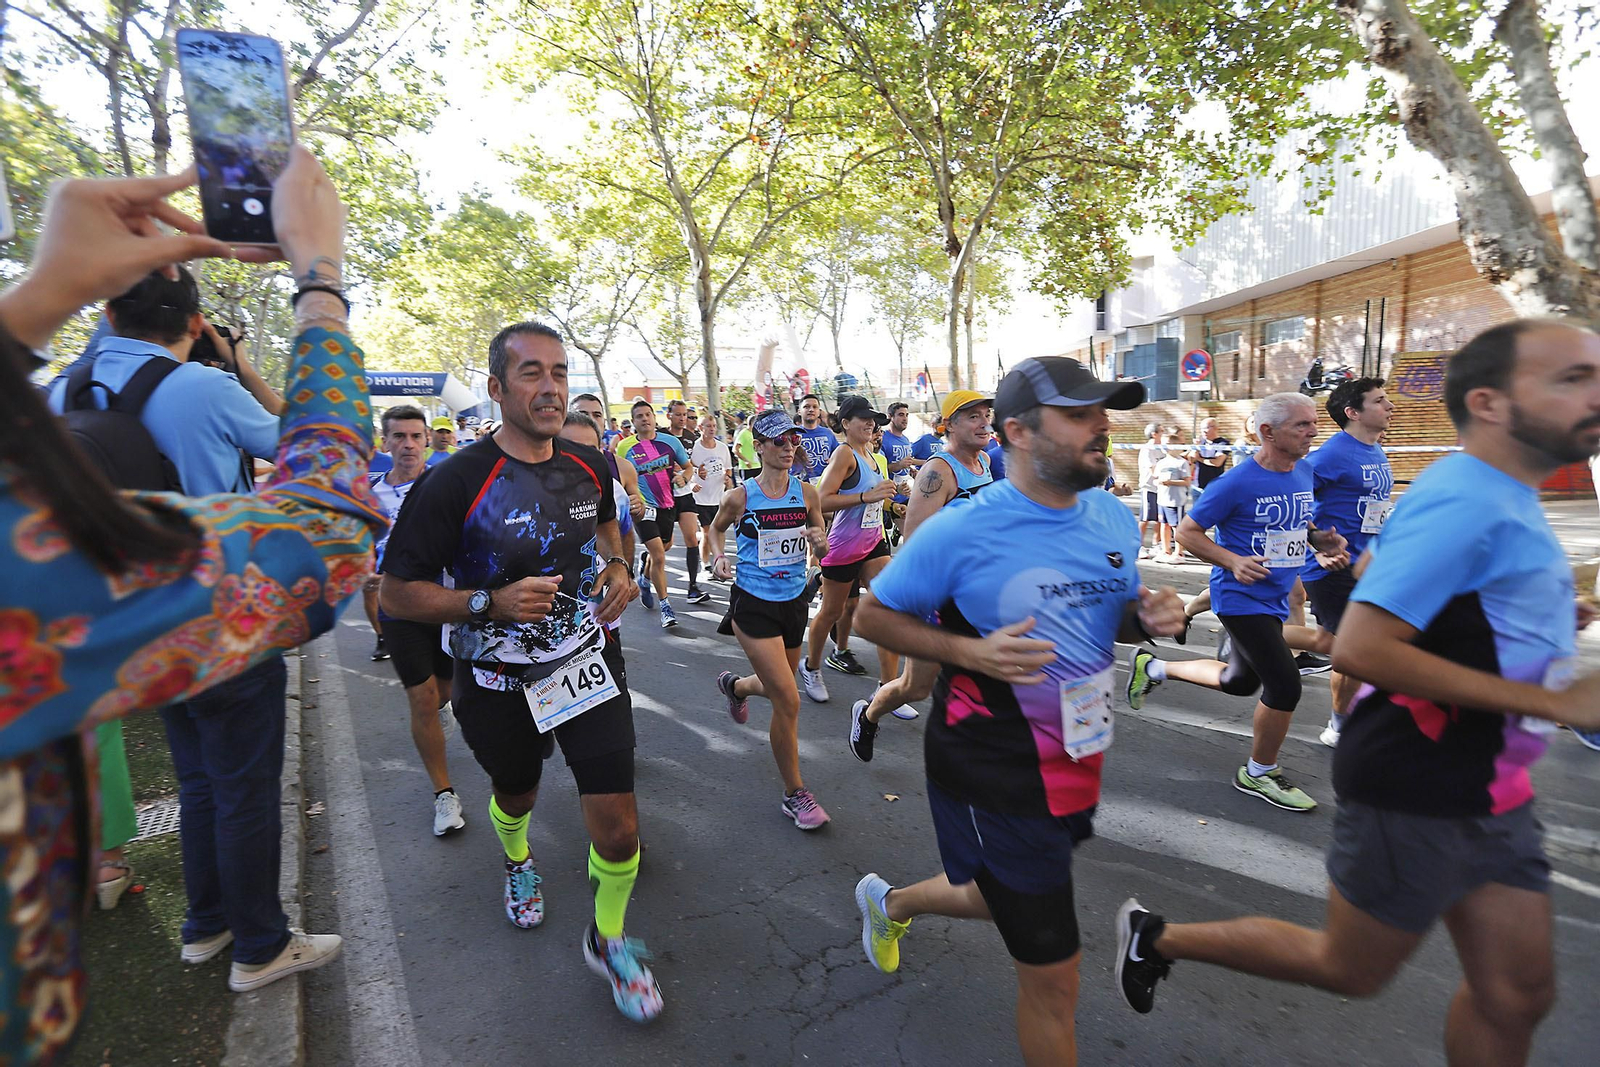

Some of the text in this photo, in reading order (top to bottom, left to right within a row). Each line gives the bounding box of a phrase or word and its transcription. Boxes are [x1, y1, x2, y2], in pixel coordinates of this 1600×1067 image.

[374, 376, 434, 386] HYUNDAI
[781, 536, 806, 555] 670
[572, 652, 594, 665] MIGUEL
[561, 662, 606, 698] 149
